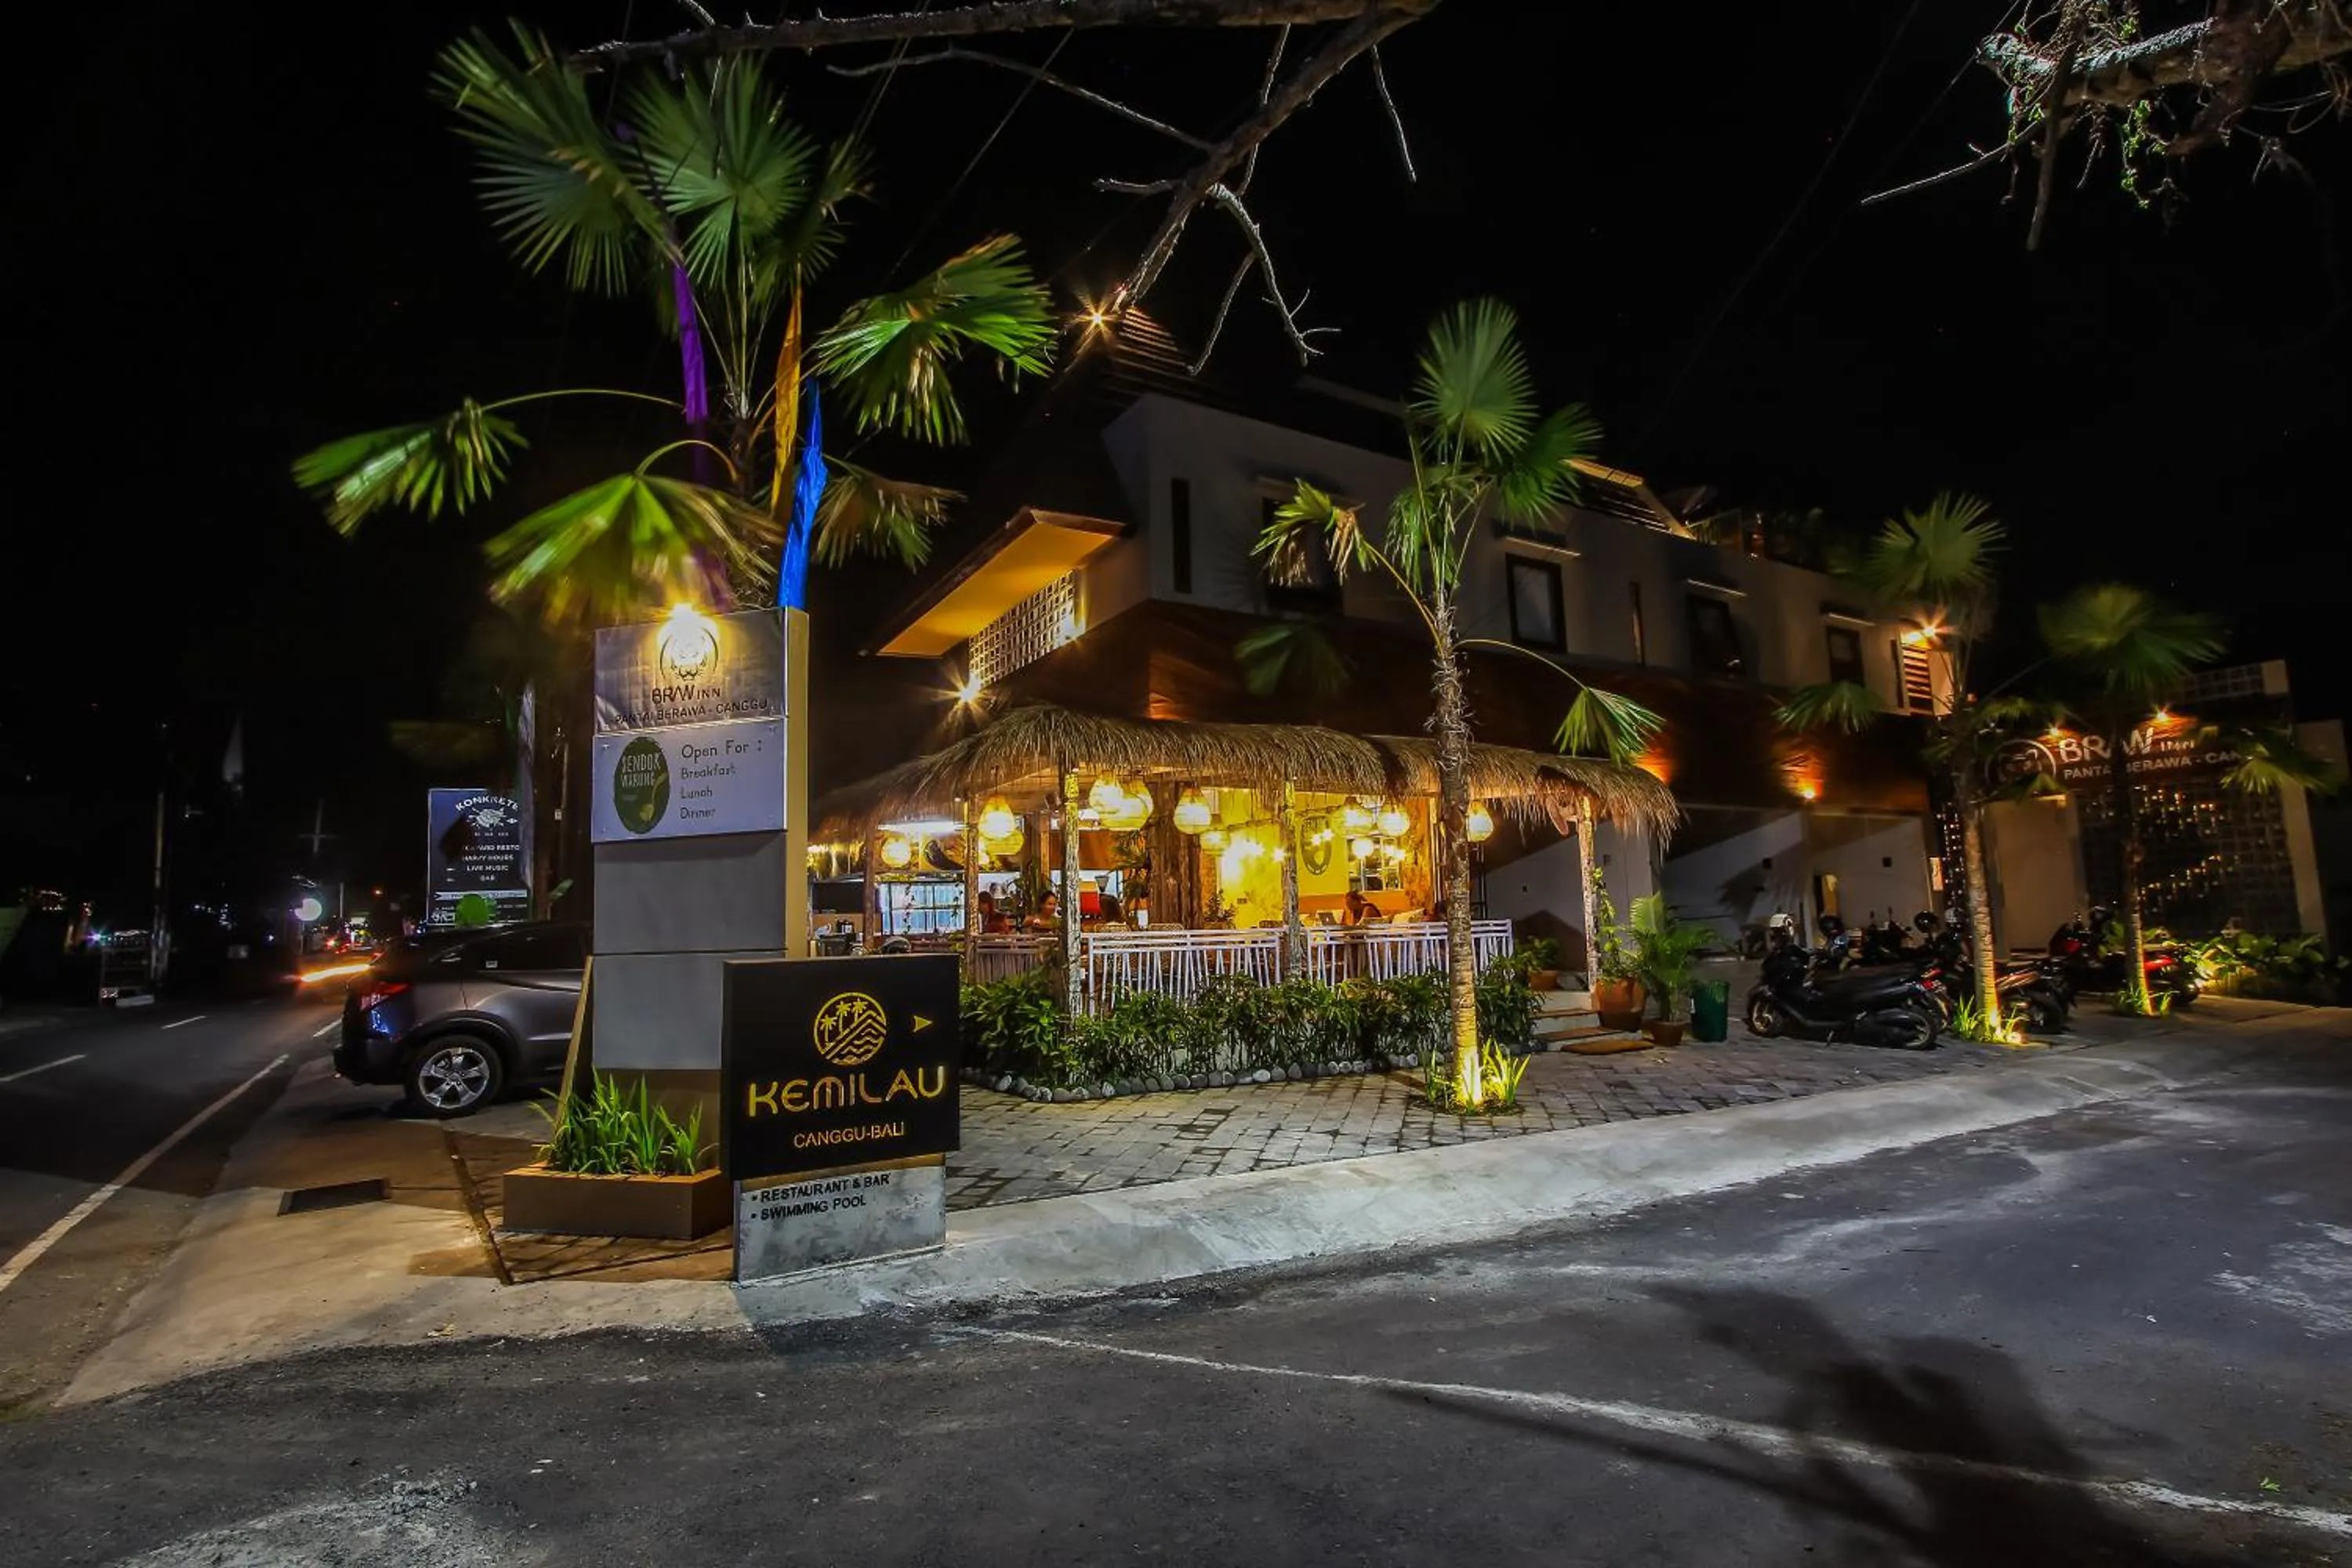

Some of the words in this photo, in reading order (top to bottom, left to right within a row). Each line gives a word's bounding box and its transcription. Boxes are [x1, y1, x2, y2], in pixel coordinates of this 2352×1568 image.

[697, 688, 721, 699] INN
[657, 706, 706, 720] BERAWA
[716, 699, 768, 714] CANGGU
[681, 745, 717, 763] Open
[726, 739, 749, 755] For
[622, 753, 661, 773] SENDOK
[681, 763, 736, 779] Breakfast
[2063, 764, 2115, 780] PANTA
[681, 786, 713, 799] Lunch
[680, 806, 716, 819] Dinner
[749, 1065, 945, 1117] KEMILAU
[793, 1121, 905, 1149] CANGGU-BALI
[760, 1179, 848, 1203] RESTAURANT
[852, 1178, 861, 1189] &
[864, 1174, 889, 1188] BAR
[760, 1200, 828, 1220] SWIMMING
[833, 1196, 866, 1210] POOL
